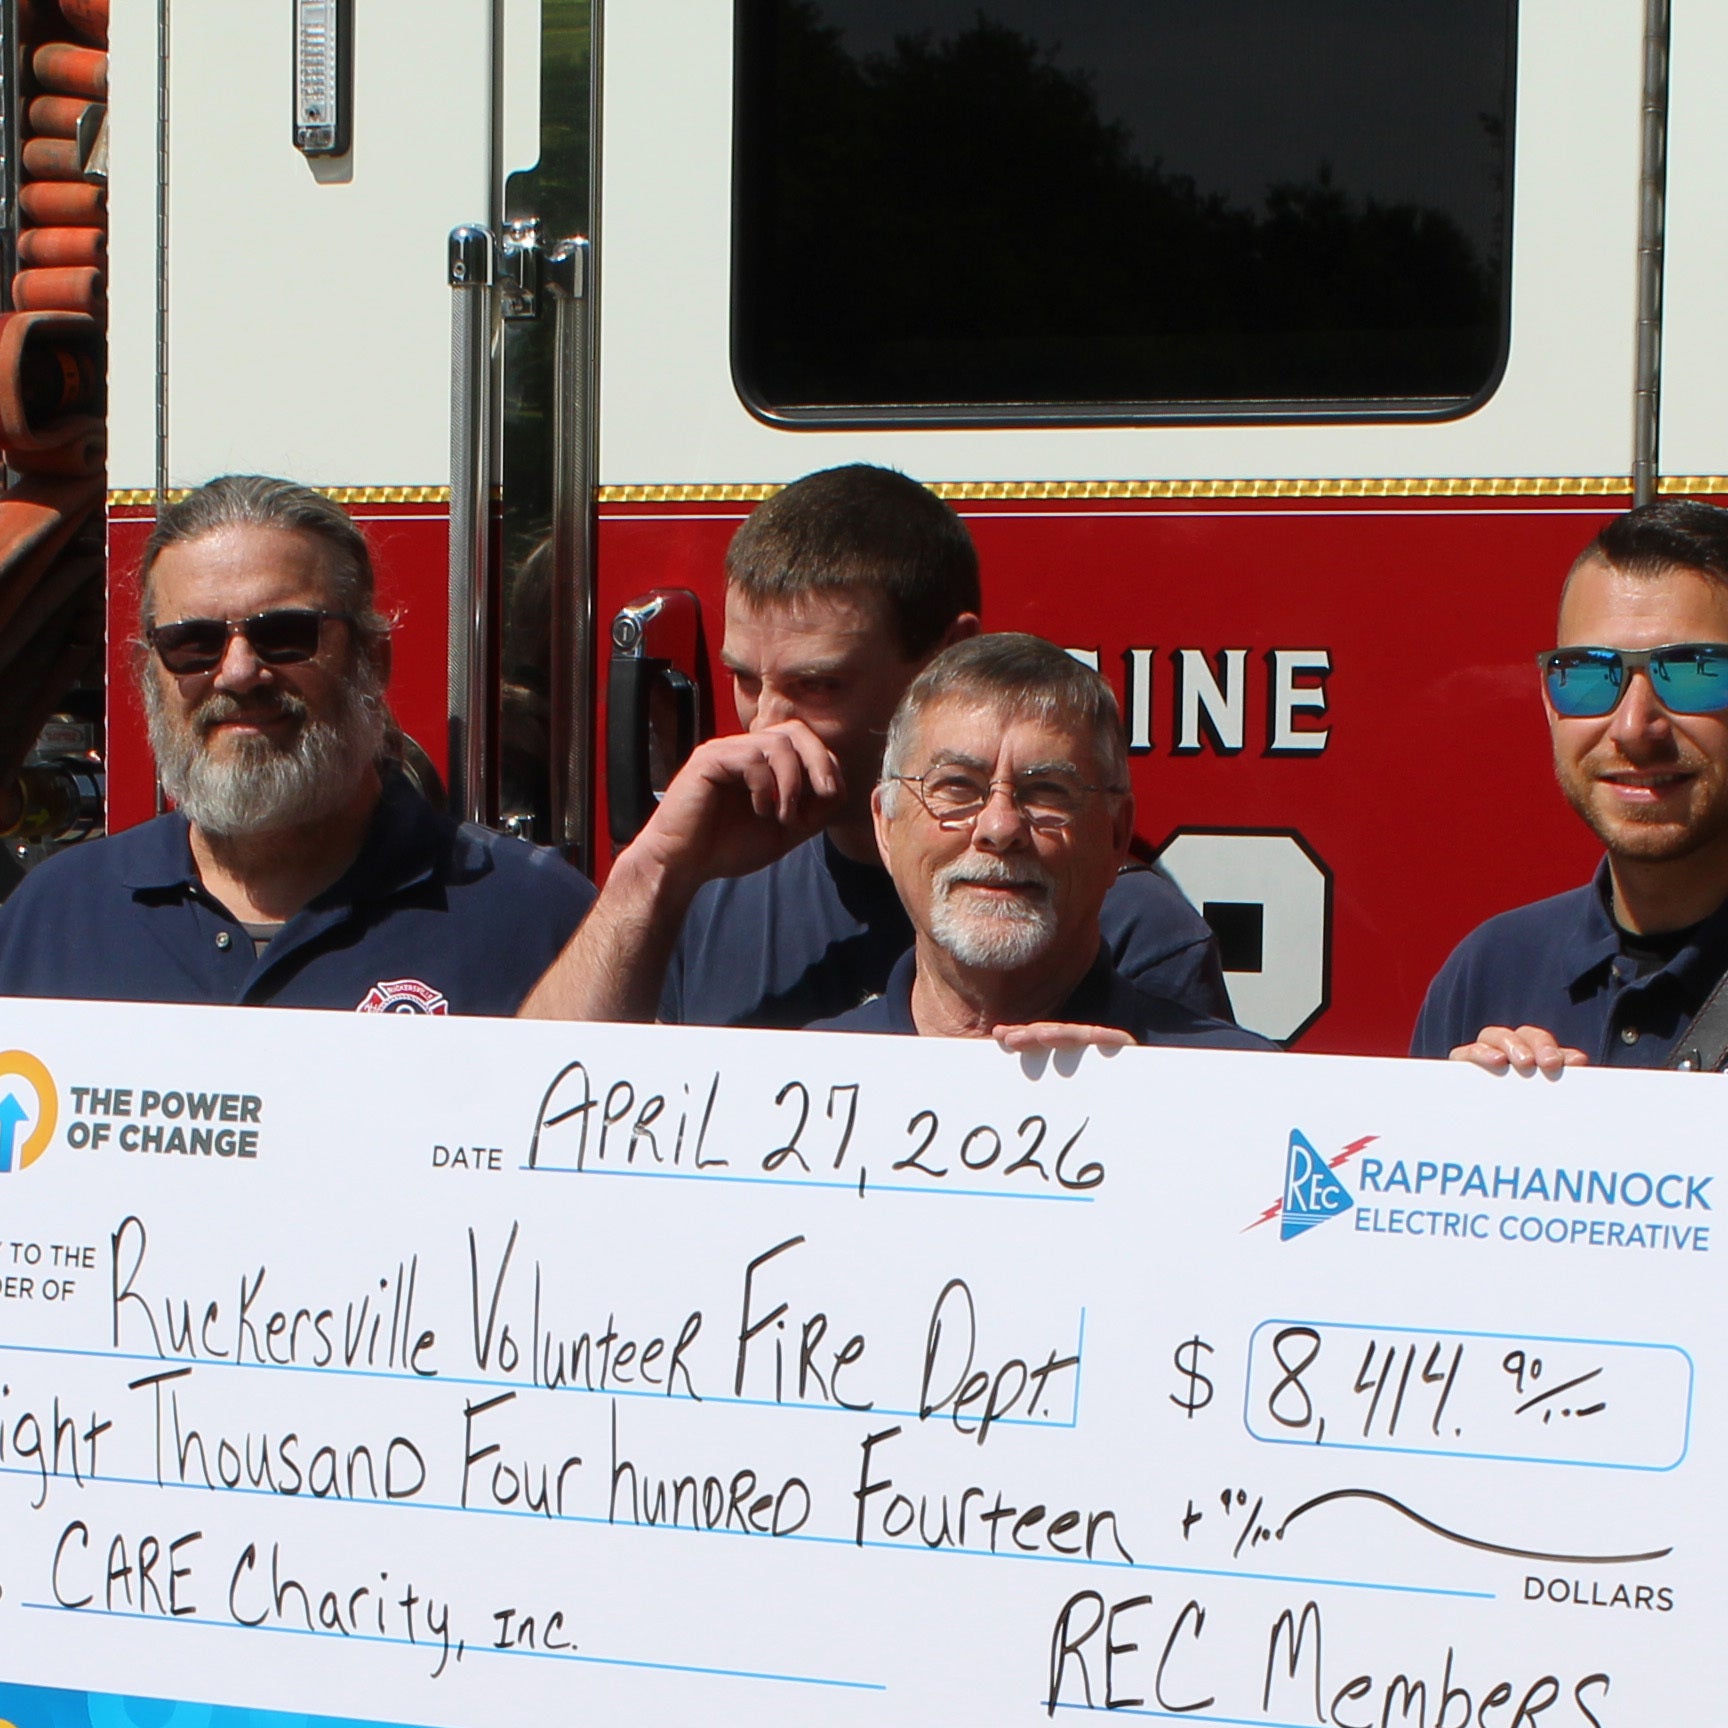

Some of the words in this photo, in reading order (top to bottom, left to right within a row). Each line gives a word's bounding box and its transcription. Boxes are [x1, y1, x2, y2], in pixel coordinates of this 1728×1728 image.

[1065, 648, 1330, 750] INE
[70, 1086, 133, 1118] THE
[140, 1090, 263, 1124] POWER
[67, 1121, 110, 1152] OF
[119, 1124, 260, 1159] CHANGE
[431, 1145, 504, 1171] DATE
[1284, 1144, 1340, 1213] REC
[1358, 1158, 1714, 1211] RAPPAHANNOCK
[1354, 1206, 1490, 1240] ELECTRIC
[1499, 1216, 1710, 1253] COOPERATIVE
[7, 1242, 42, 1267] TO
[49, 1245, 96, 1271] THE
[42, 1278, 76, 1302] OF
[1170, 1335, 1214, 1418] $
[460, 1390, 583, 1519] Four
[852, 1426, 1135, 1566] Fourteen
[50, 1520, 203, 1616] CARE
[228, 1542, 466, 1678] Charity,
[1523, 1577, 1674, 1613] DOLLARS
[1046, 1590, 1216, 1718] REC
